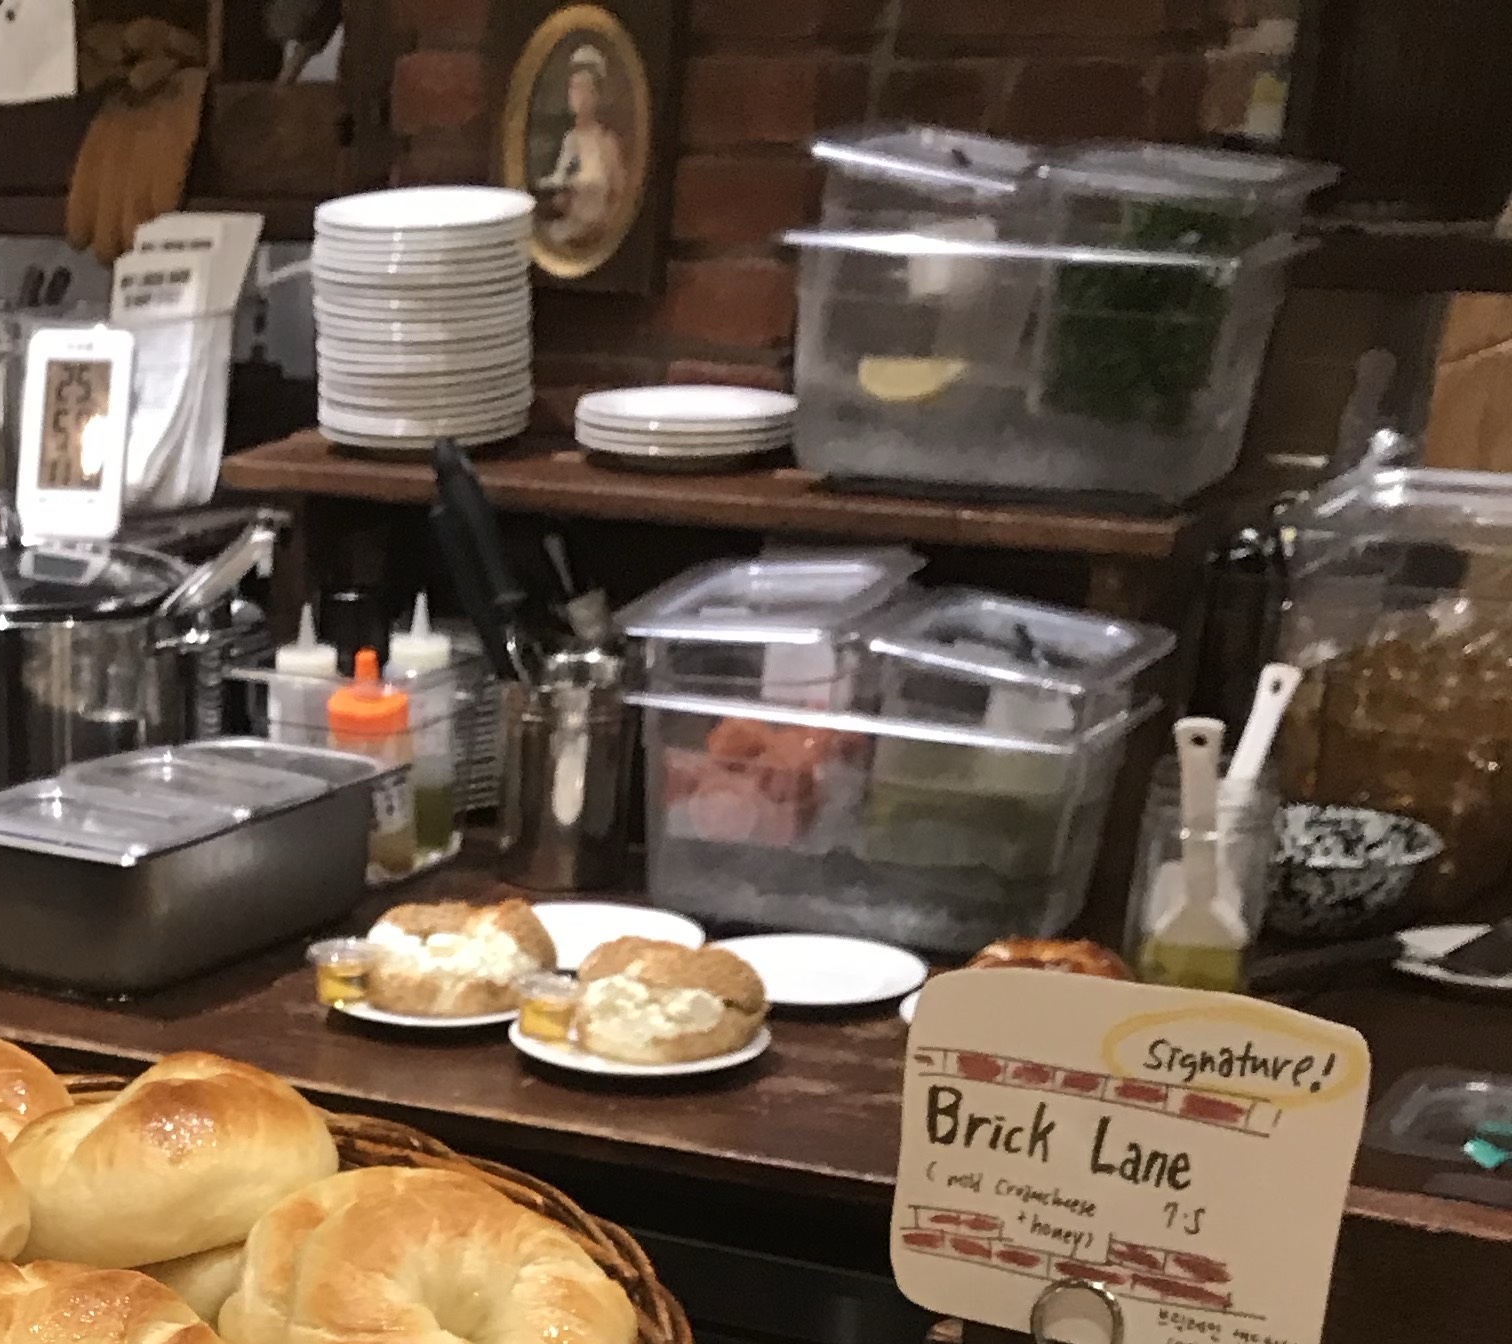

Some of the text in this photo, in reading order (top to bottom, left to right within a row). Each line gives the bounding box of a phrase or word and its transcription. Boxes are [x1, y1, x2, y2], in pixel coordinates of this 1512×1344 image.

[1142, 1038, 1337, 1093] Signature!
[926, 1085, 1192, 1190] Brick Lane
